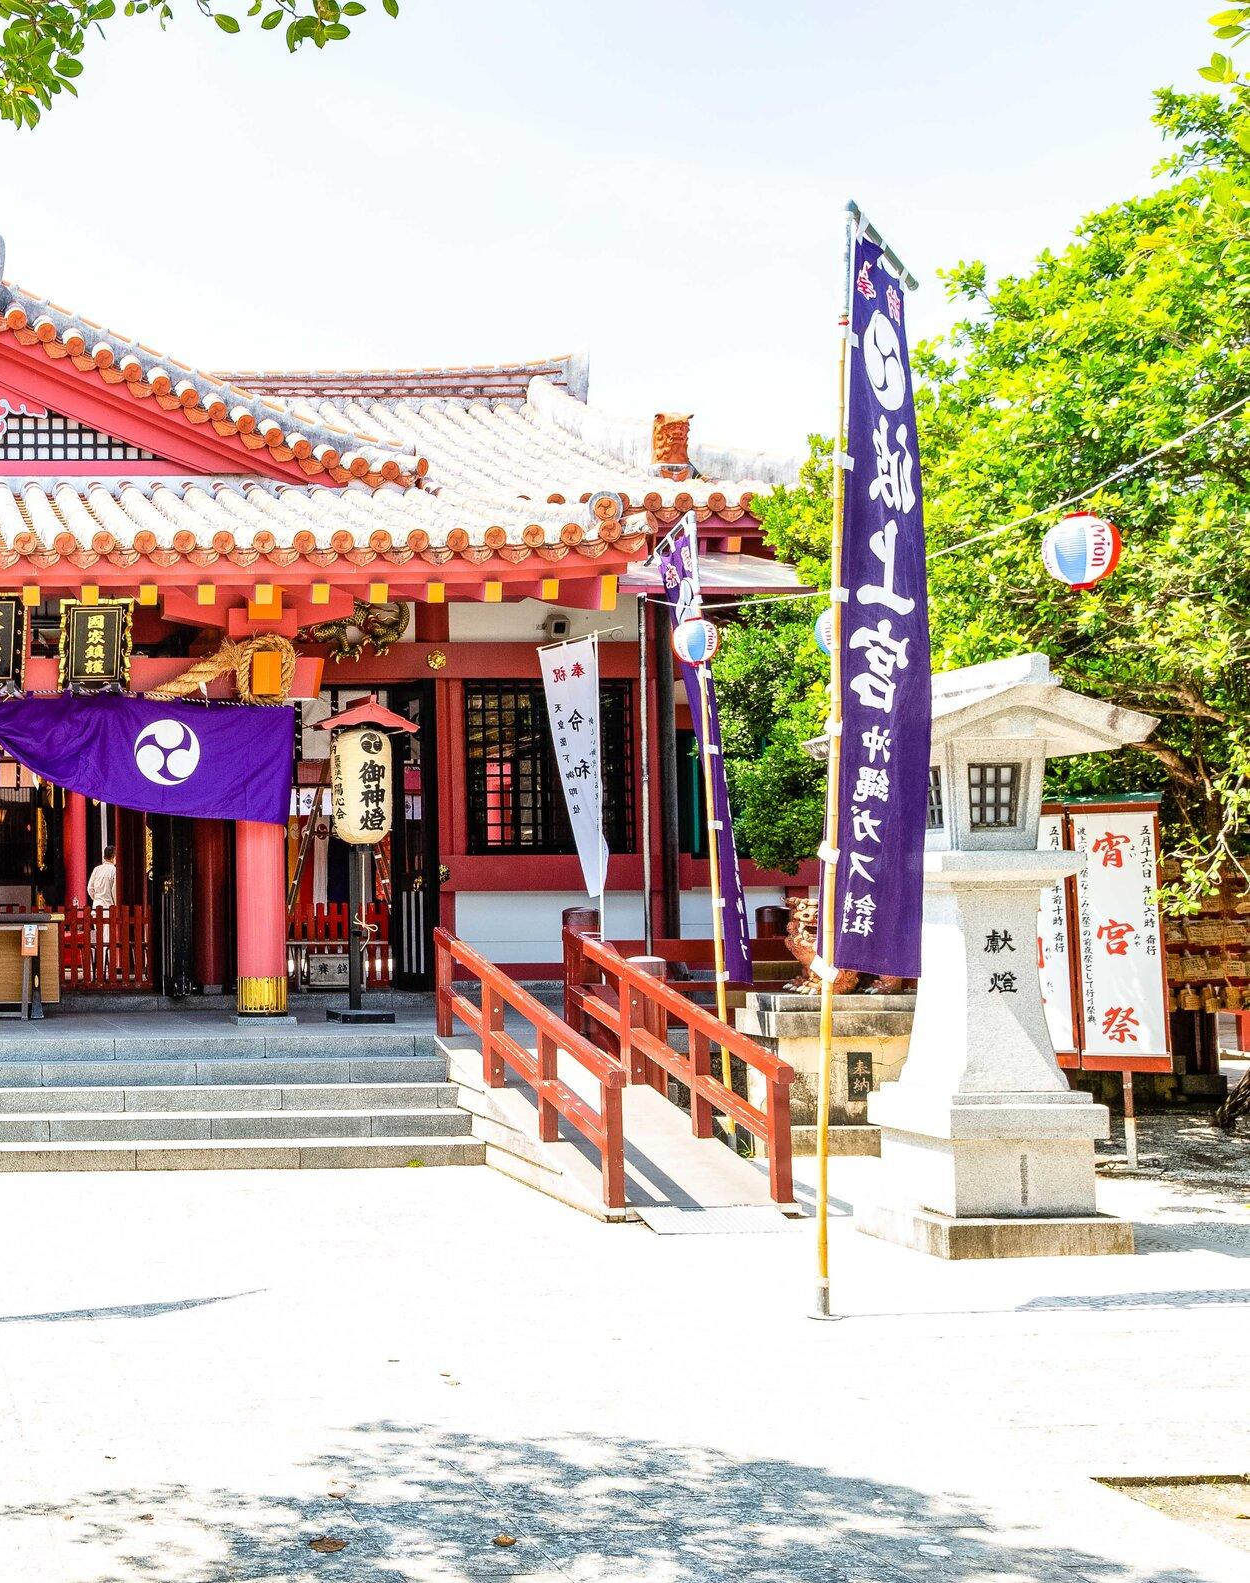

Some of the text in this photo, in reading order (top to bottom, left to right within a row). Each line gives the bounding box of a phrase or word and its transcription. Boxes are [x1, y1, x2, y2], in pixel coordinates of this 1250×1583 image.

[1091, 525, 1110, 567] Orion
[359, 759, 386, 831] 御神燈
[1092, 831, 1140, 1043] 宵宮祭
[852, 1060, 871, 1094] 奉納
